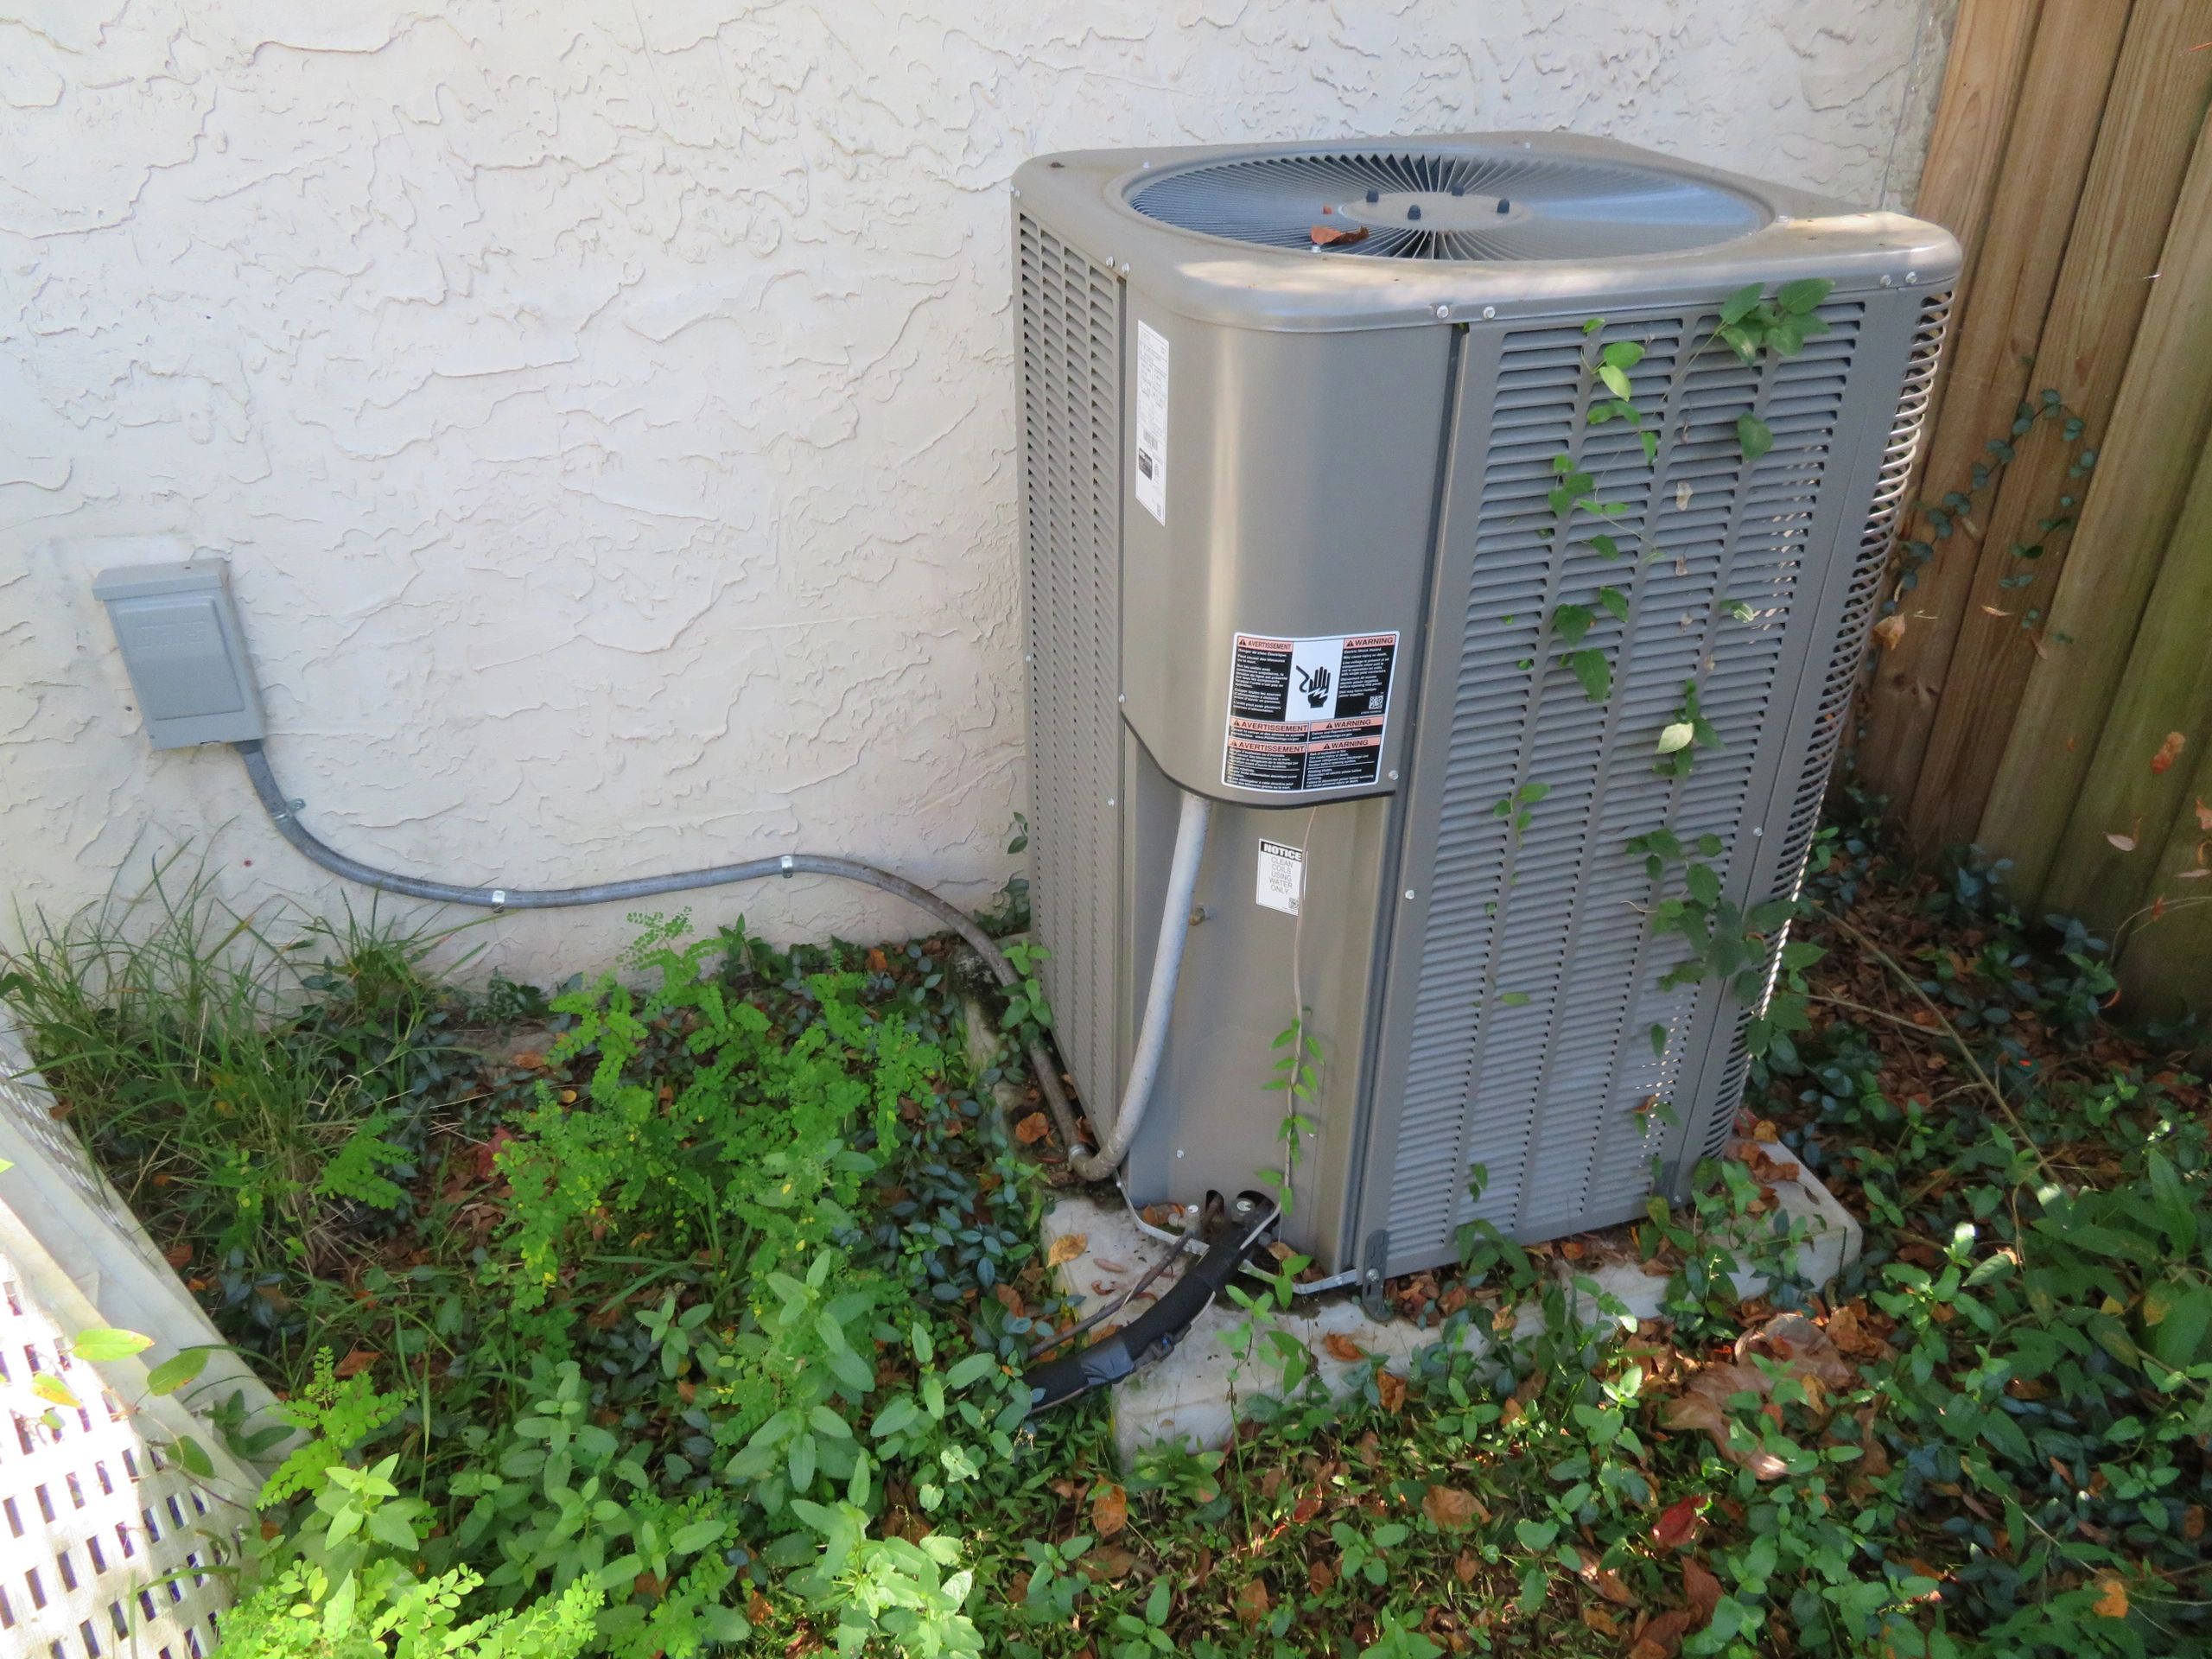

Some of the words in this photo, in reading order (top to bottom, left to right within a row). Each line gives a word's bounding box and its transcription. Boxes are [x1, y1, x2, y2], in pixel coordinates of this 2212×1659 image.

[1249, 640, 1291, 650] AVERTISSEMENT
[1355, 637, 1393, 646] WARNING
[1242, 721, 1307, 732] AVERTISSEMENT
[1334, 719, 1371, 728] WARNING
[1238, 742, 1304, 753] AVERTISSEMENT
[1332, 740, 1368, 749] WARNING
[1264, 843, 1302, 861] NOTICE
[1272, 856, 1294, 868] CLEAN
[1271, 871, 1292, 881] USING
[1269, 877, 1293, 888] WATER
[1270, 885, 1289, 894] ONLY
